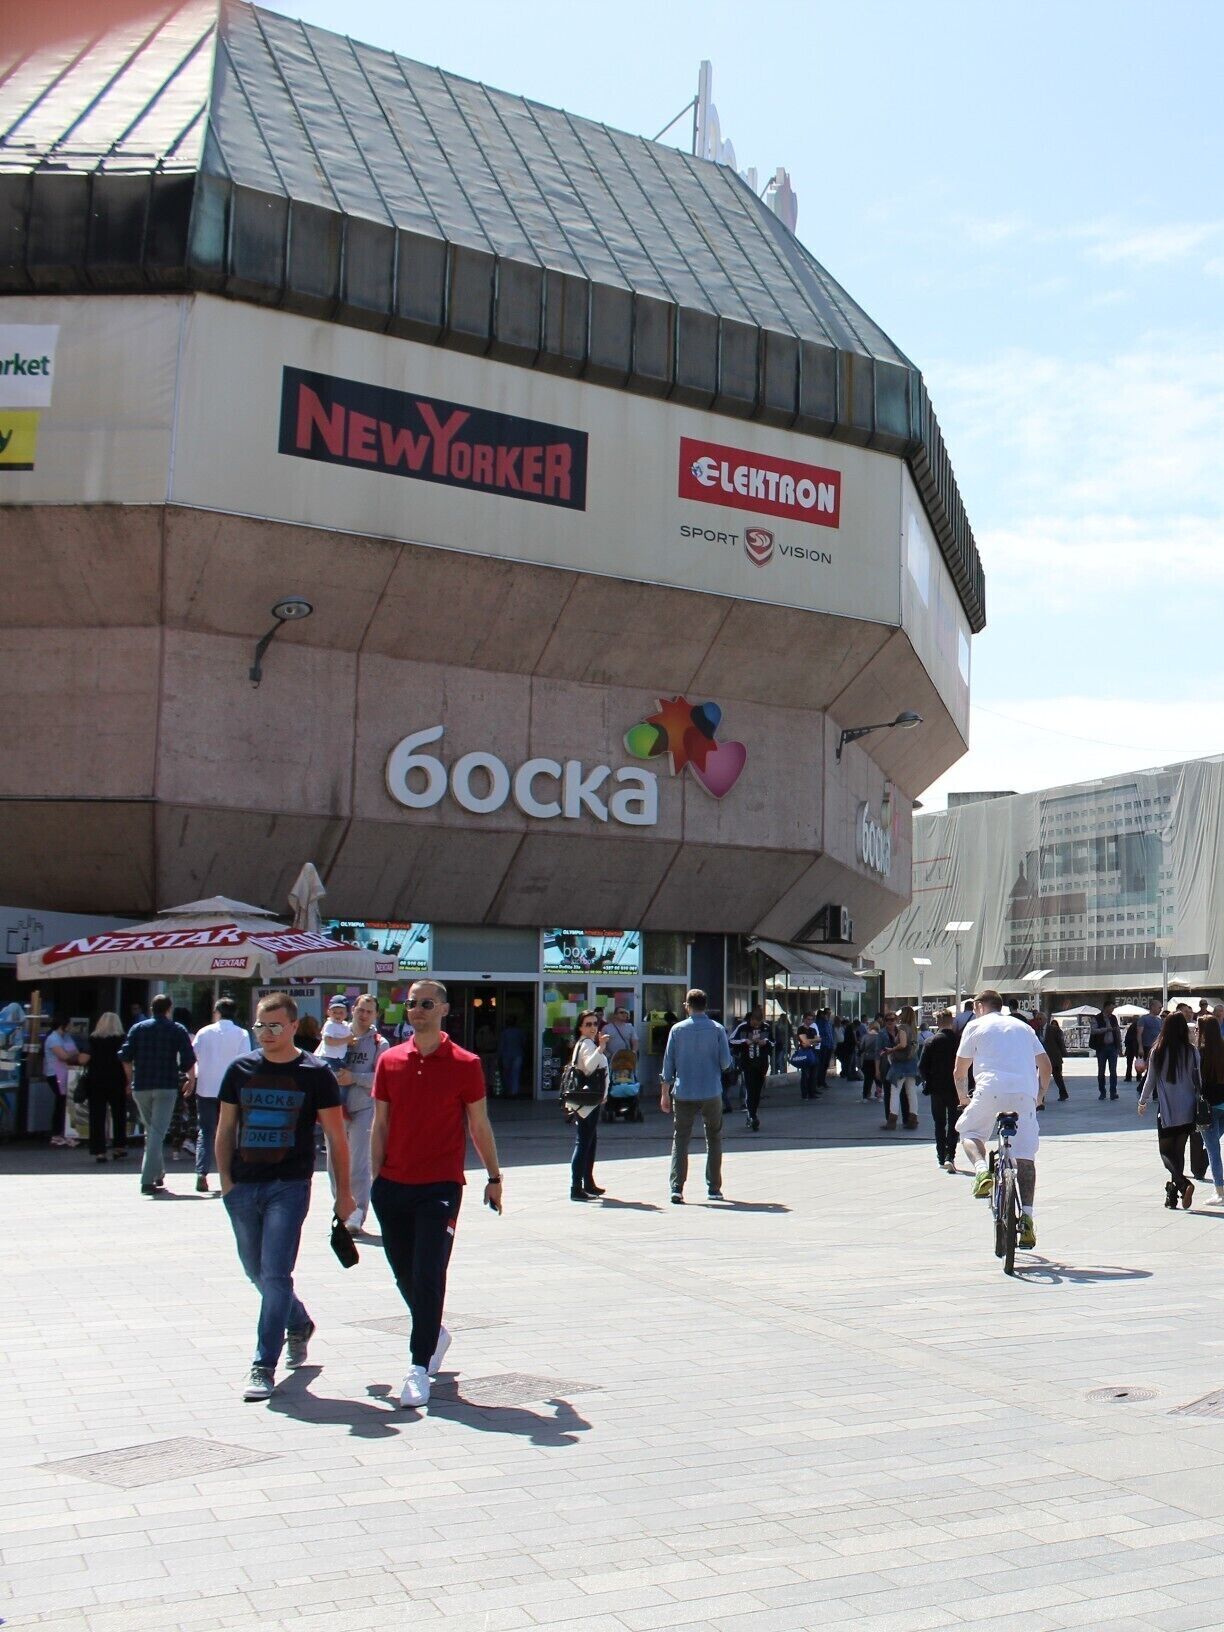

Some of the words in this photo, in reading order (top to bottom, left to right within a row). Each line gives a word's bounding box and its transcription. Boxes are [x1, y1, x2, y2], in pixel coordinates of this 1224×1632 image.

[691, 456, 835, 513] ELEKTRON
[680, 525, 739, 546] SPORT
[779, 544, 832, 564] VISION
[57, 926, 242, 953] NEKTAR
[247, 931, 345, 952] NEKTAR
[563, 941, 588, 958] box
[212, 959, 246, 968] NEKTAR
